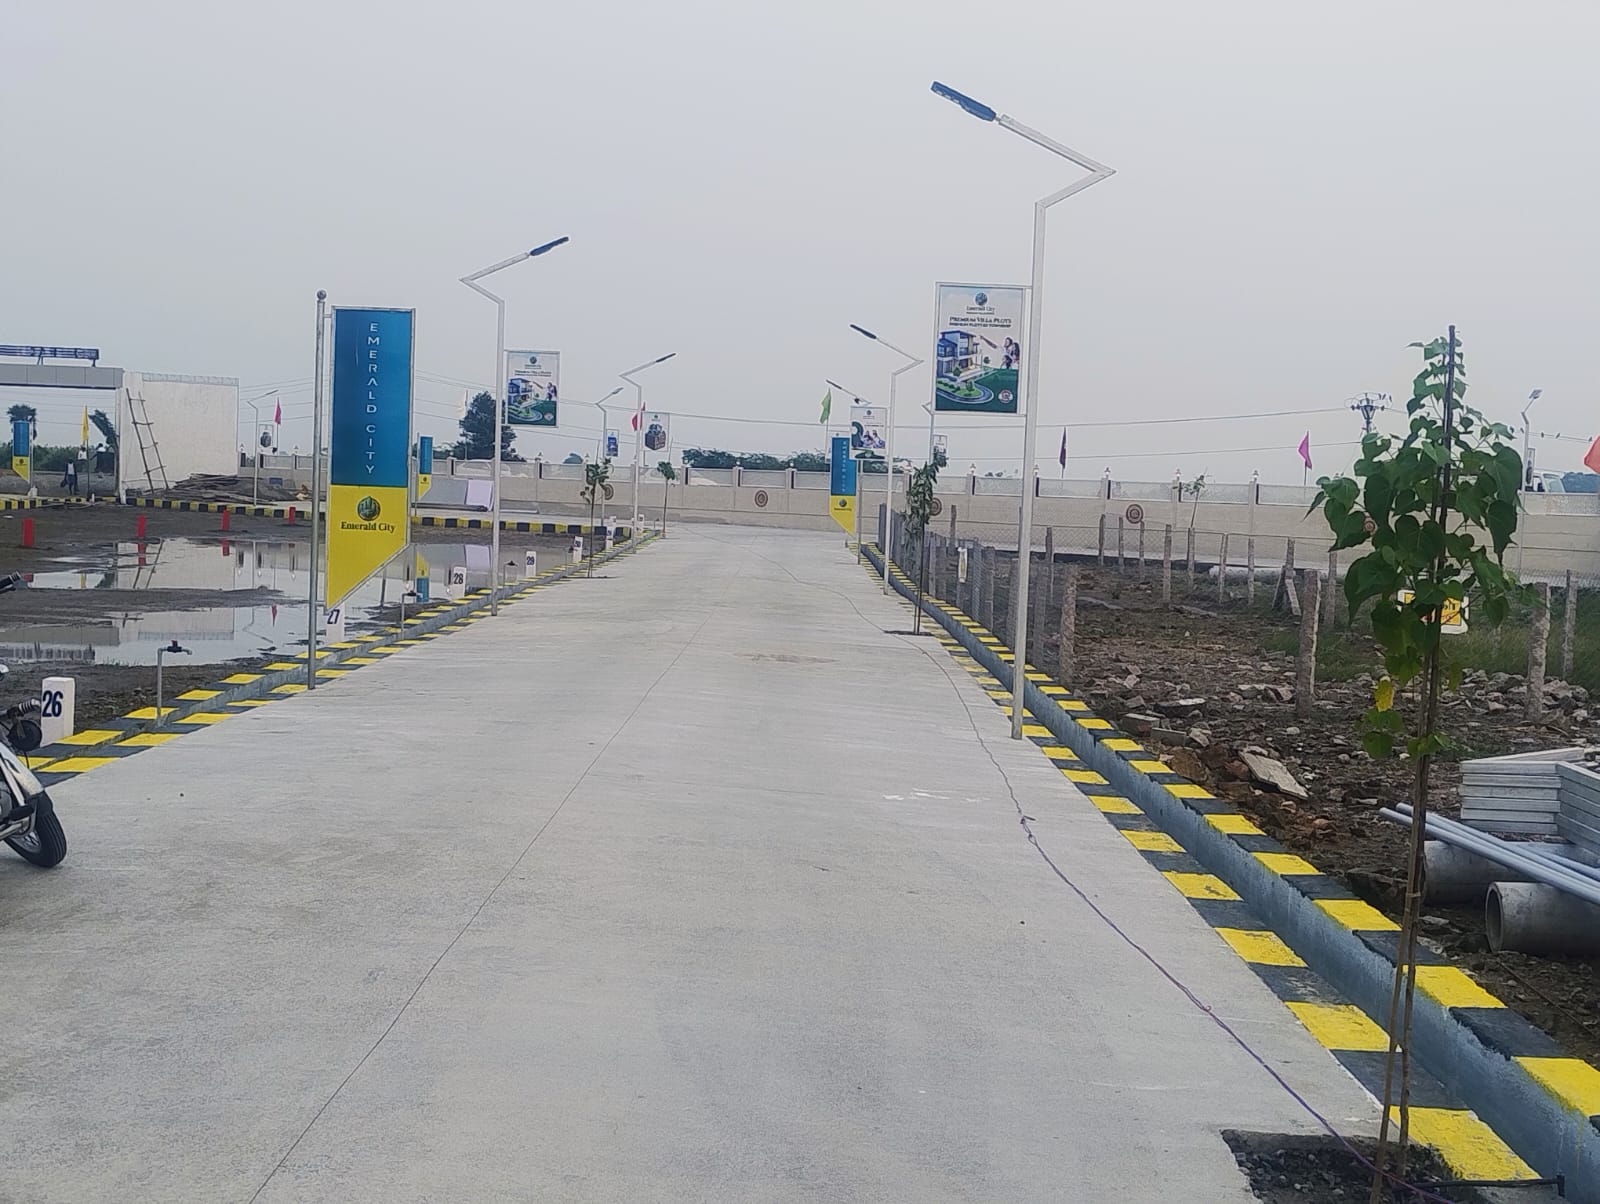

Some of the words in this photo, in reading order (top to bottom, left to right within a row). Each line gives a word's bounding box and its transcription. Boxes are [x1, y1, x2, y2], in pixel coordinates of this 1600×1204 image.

[367, 323, 380, 413] EMERALD
[366, 424, 376, 474] CITY
[341, 521, 377, 531] Emerald
[378, 523, 396, 533] City
[526, 556, 535, 565] 29
[453, 572, 464, 584] 28
[327, 609, 340, 624] 27
[42, 690, 63, 717] 26
